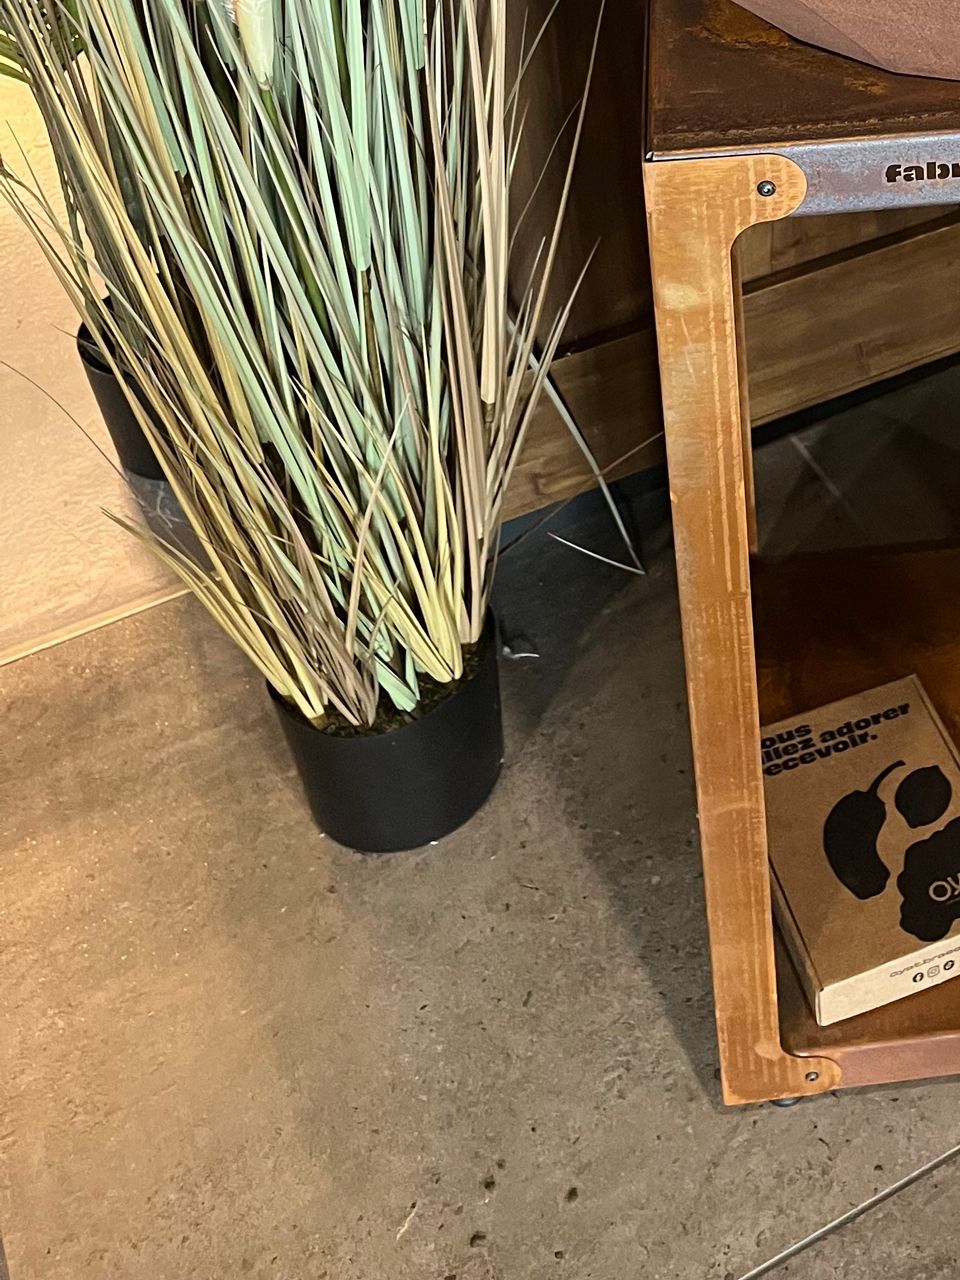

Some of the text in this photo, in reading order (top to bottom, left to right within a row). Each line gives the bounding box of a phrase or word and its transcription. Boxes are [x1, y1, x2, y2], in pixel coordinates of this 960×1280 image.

[760, 724, 812, 749] ous
[819, 703, 910, 744] adorer
[764, 732, 878, 776] ecevoir.
